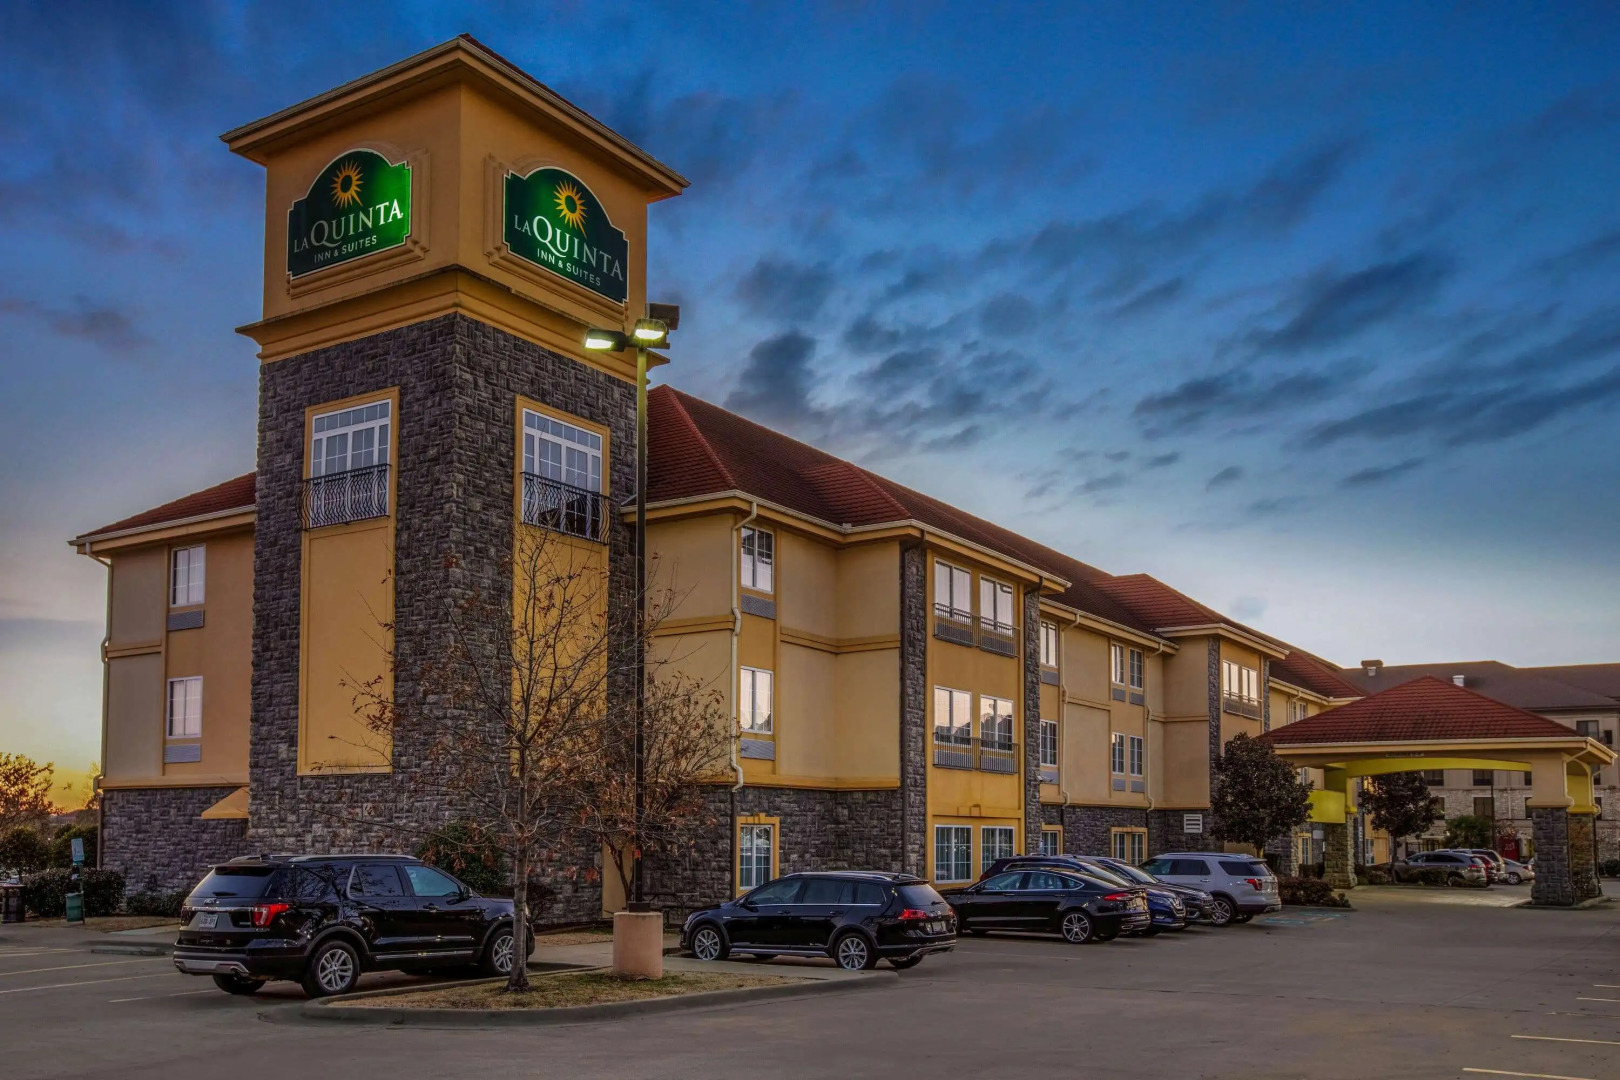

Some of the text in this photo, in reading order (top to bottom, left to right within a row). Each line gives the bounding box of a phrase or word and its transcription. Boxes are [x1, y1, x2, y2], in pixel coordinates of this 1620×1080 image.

[294, 198, 403, 253] LA QUINTA
[514, 214, 624, 282] LA QUINTA
[314, 235, 377, 264] INN & SUITES
[537, 248, 601, 286] INN & SUITES
